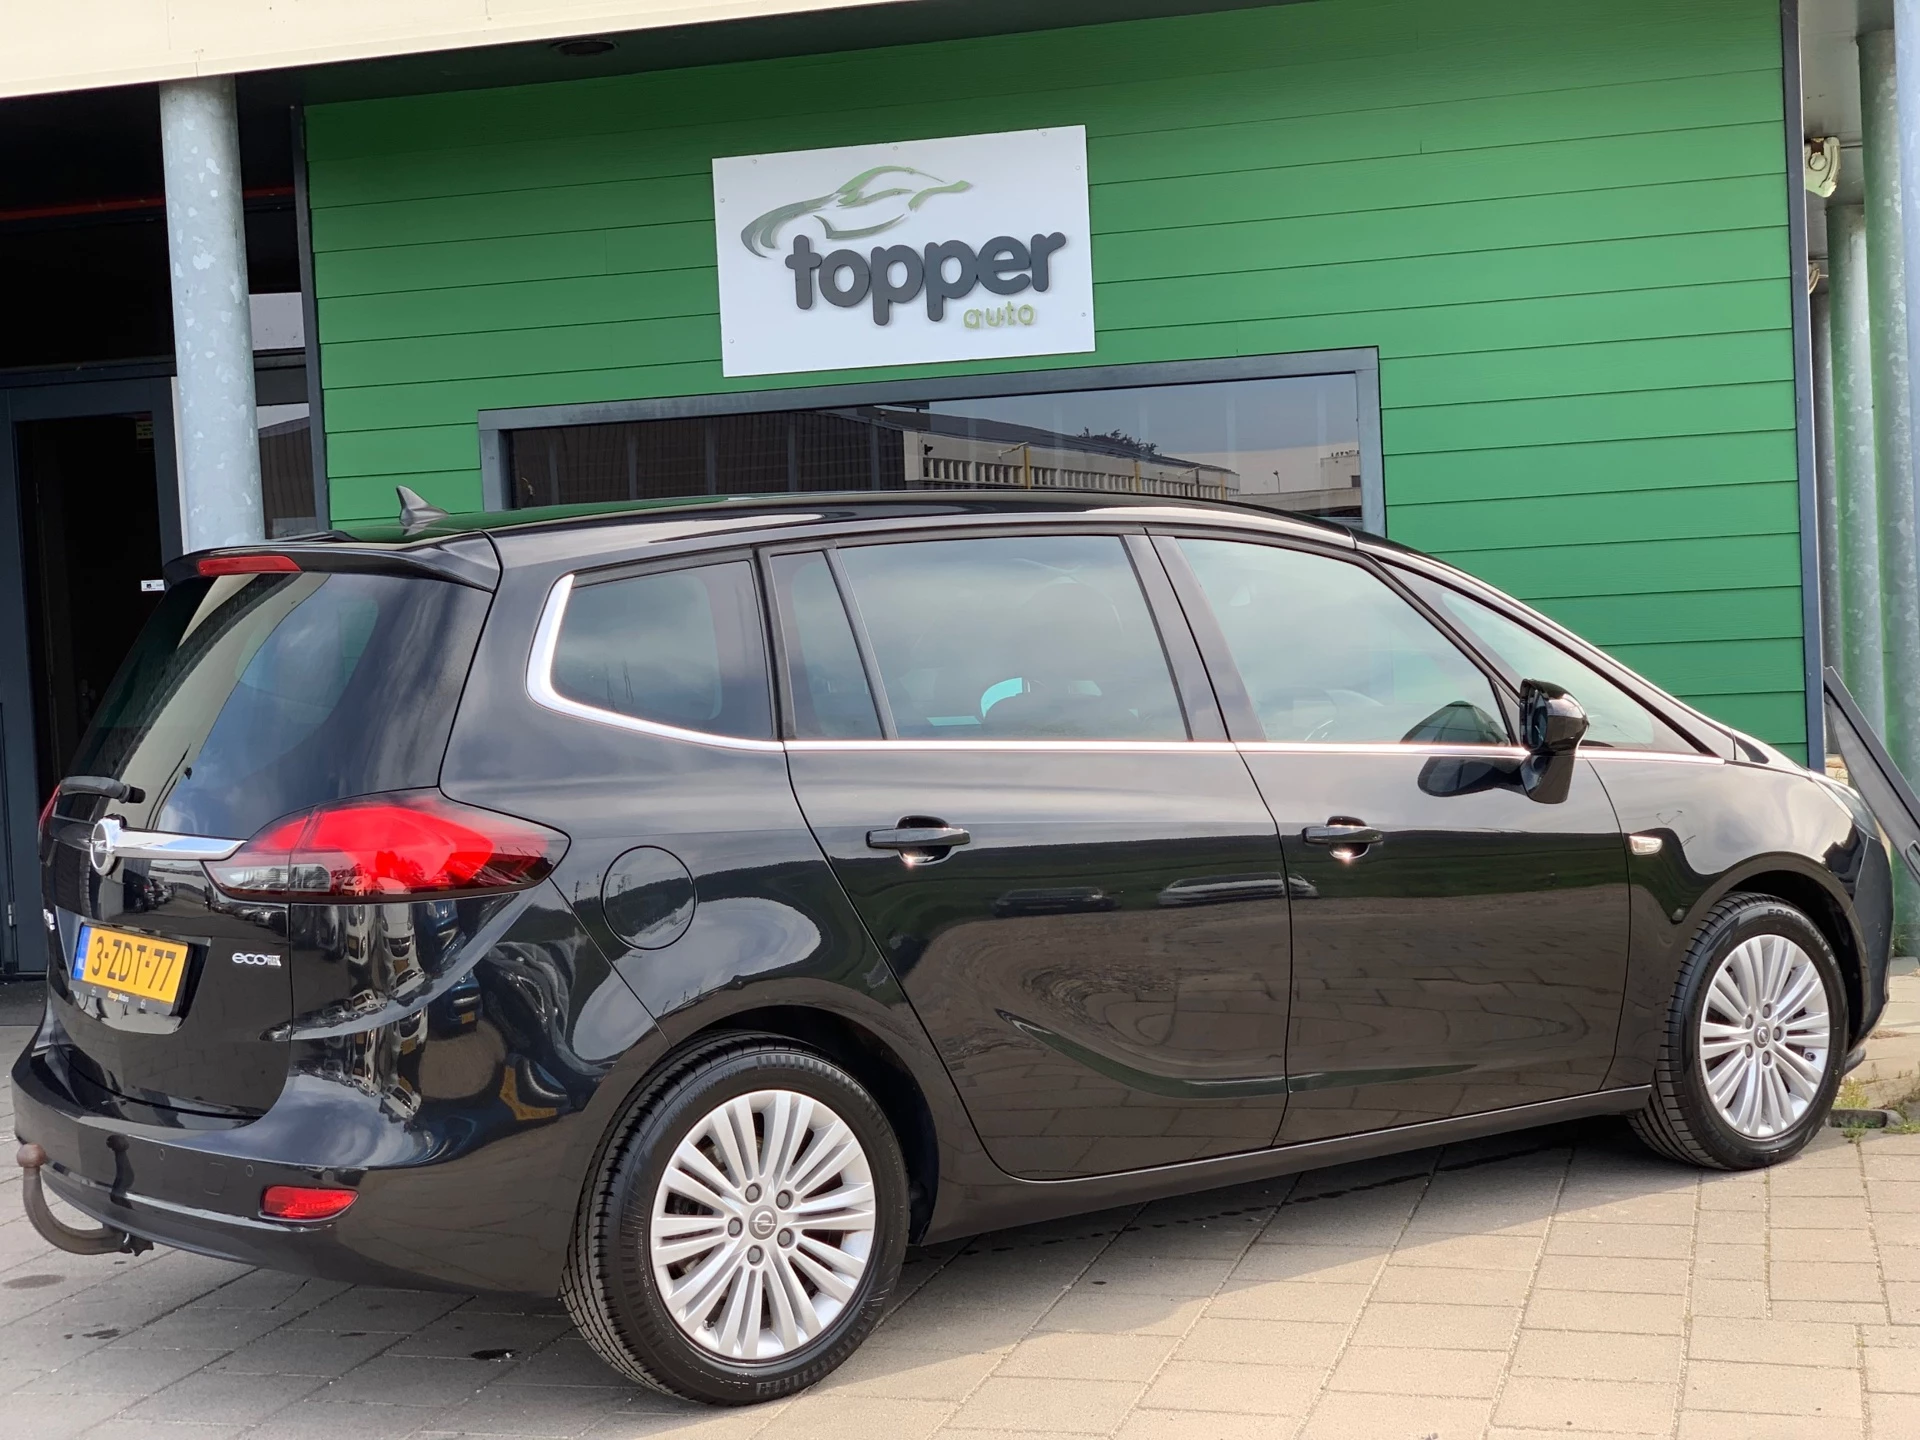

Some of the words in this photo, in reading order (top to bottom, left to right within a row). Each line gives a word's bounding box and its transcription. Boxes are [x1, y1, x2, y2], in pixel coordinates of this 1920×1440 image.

[785, 231, 1067, 326] topper
[963, 301, 1035, 329] auto
[92, 936, 176, 991] 3-ZDT-77
